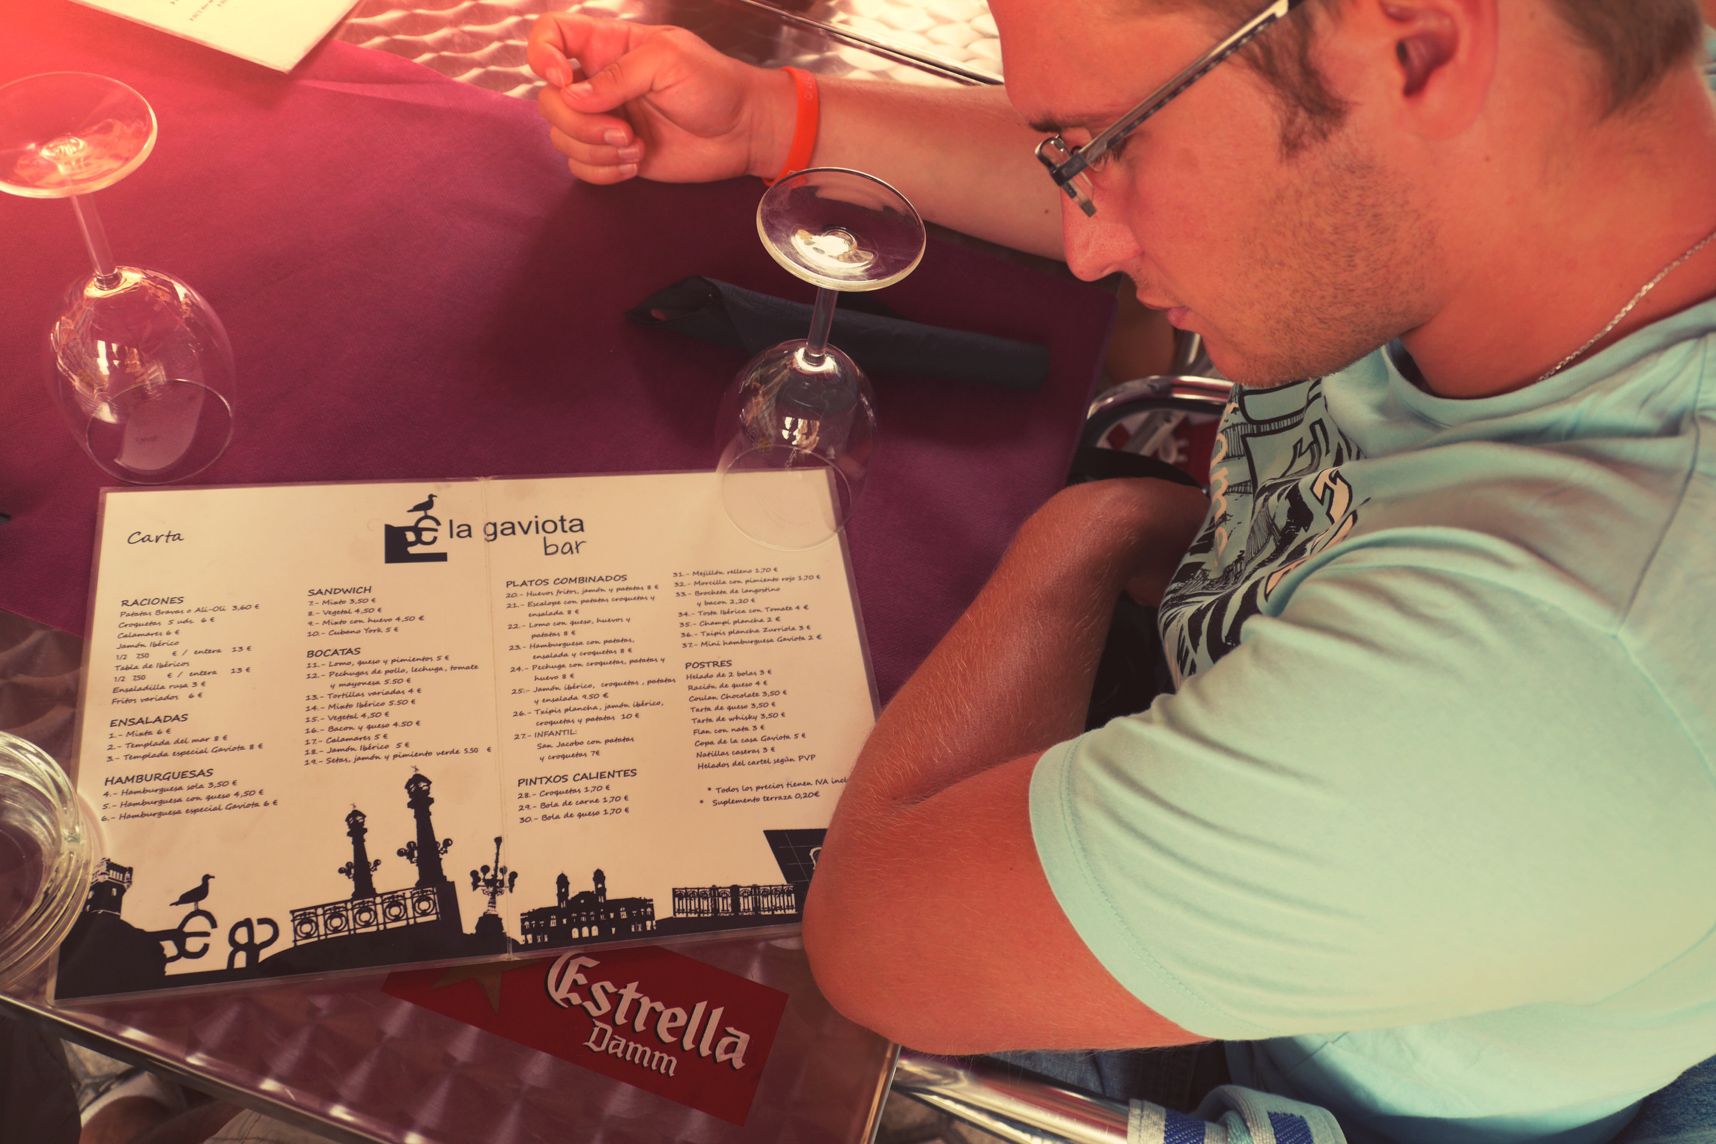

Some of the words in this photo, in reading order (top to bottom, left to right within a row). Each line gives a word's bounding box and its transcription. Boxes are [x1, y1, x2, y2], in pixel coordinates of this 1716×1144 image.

[449, 518, 472, 539] la
[483, 514, 585, 542] gaviota
[127, 530, 184, 546] Carta
[543, 535, 587, 556] bar
[506, 579, 549, 588] PLATOS
[553, 575, 627, 585] COMBINADOS
[308, 586, 372, 596] SANDWICH
[121, 596, 184, 607] RACIONES
[728, 628, 760, 636] plancha
[529, 642, 583, 650] Hamburguesa
[307, 648, 361, 658] BOCATAS
[391, 655, 433, 664] pimientos
[685, 660, 732, 669] POSTRES
[329, 670, 368, 678] Pechugas
[112, 684, 165, 693] Ensaladilla
[141, 694, 178, 702] variados
[542, 695, 578, 703] ensalada
[720, 692, 760, 700] Chocolate
[110, 714, 188, 727] ENSALADAS
[328, 713, 358, 722] Vegetal
[728, 714, 757, 722] whisky
[126, 740, 170, 748] Templada
[326, 736, 371, 744] Calamares
[695, 739, 714, 747] Copa
[124, 752, 168, 761] Templada
[172, 748, 208, 756] especial
[392, 751, 432, 760] pimiento
[732, 748, 760, 756] caseras
[798, 754, 816, 762] PVP
[104, 768, 214, 786] HAMBURGUESAS
[518, 775, 568, 787] PINTXOS
[573, 769, 638, 782] CALIENTES
[755, 782, 784, 791] precios
[121, 786, 183, 797] Hamburguesa
[539, 788, 581, 797] Croquetas
[120, 798, 182, 809] Hamburguesa
[712, 797, 760, 806] Suplemento
[763, 794, 793, 802] terraza
[119, 810, 181, 820] Hamburguesa
[225, 802, 259, 810] Gaviota
[578, 810, 600, 818] queso
[547, 950, 750, 1070] Estrella
[584, 1020, 678, 1077] Damm
